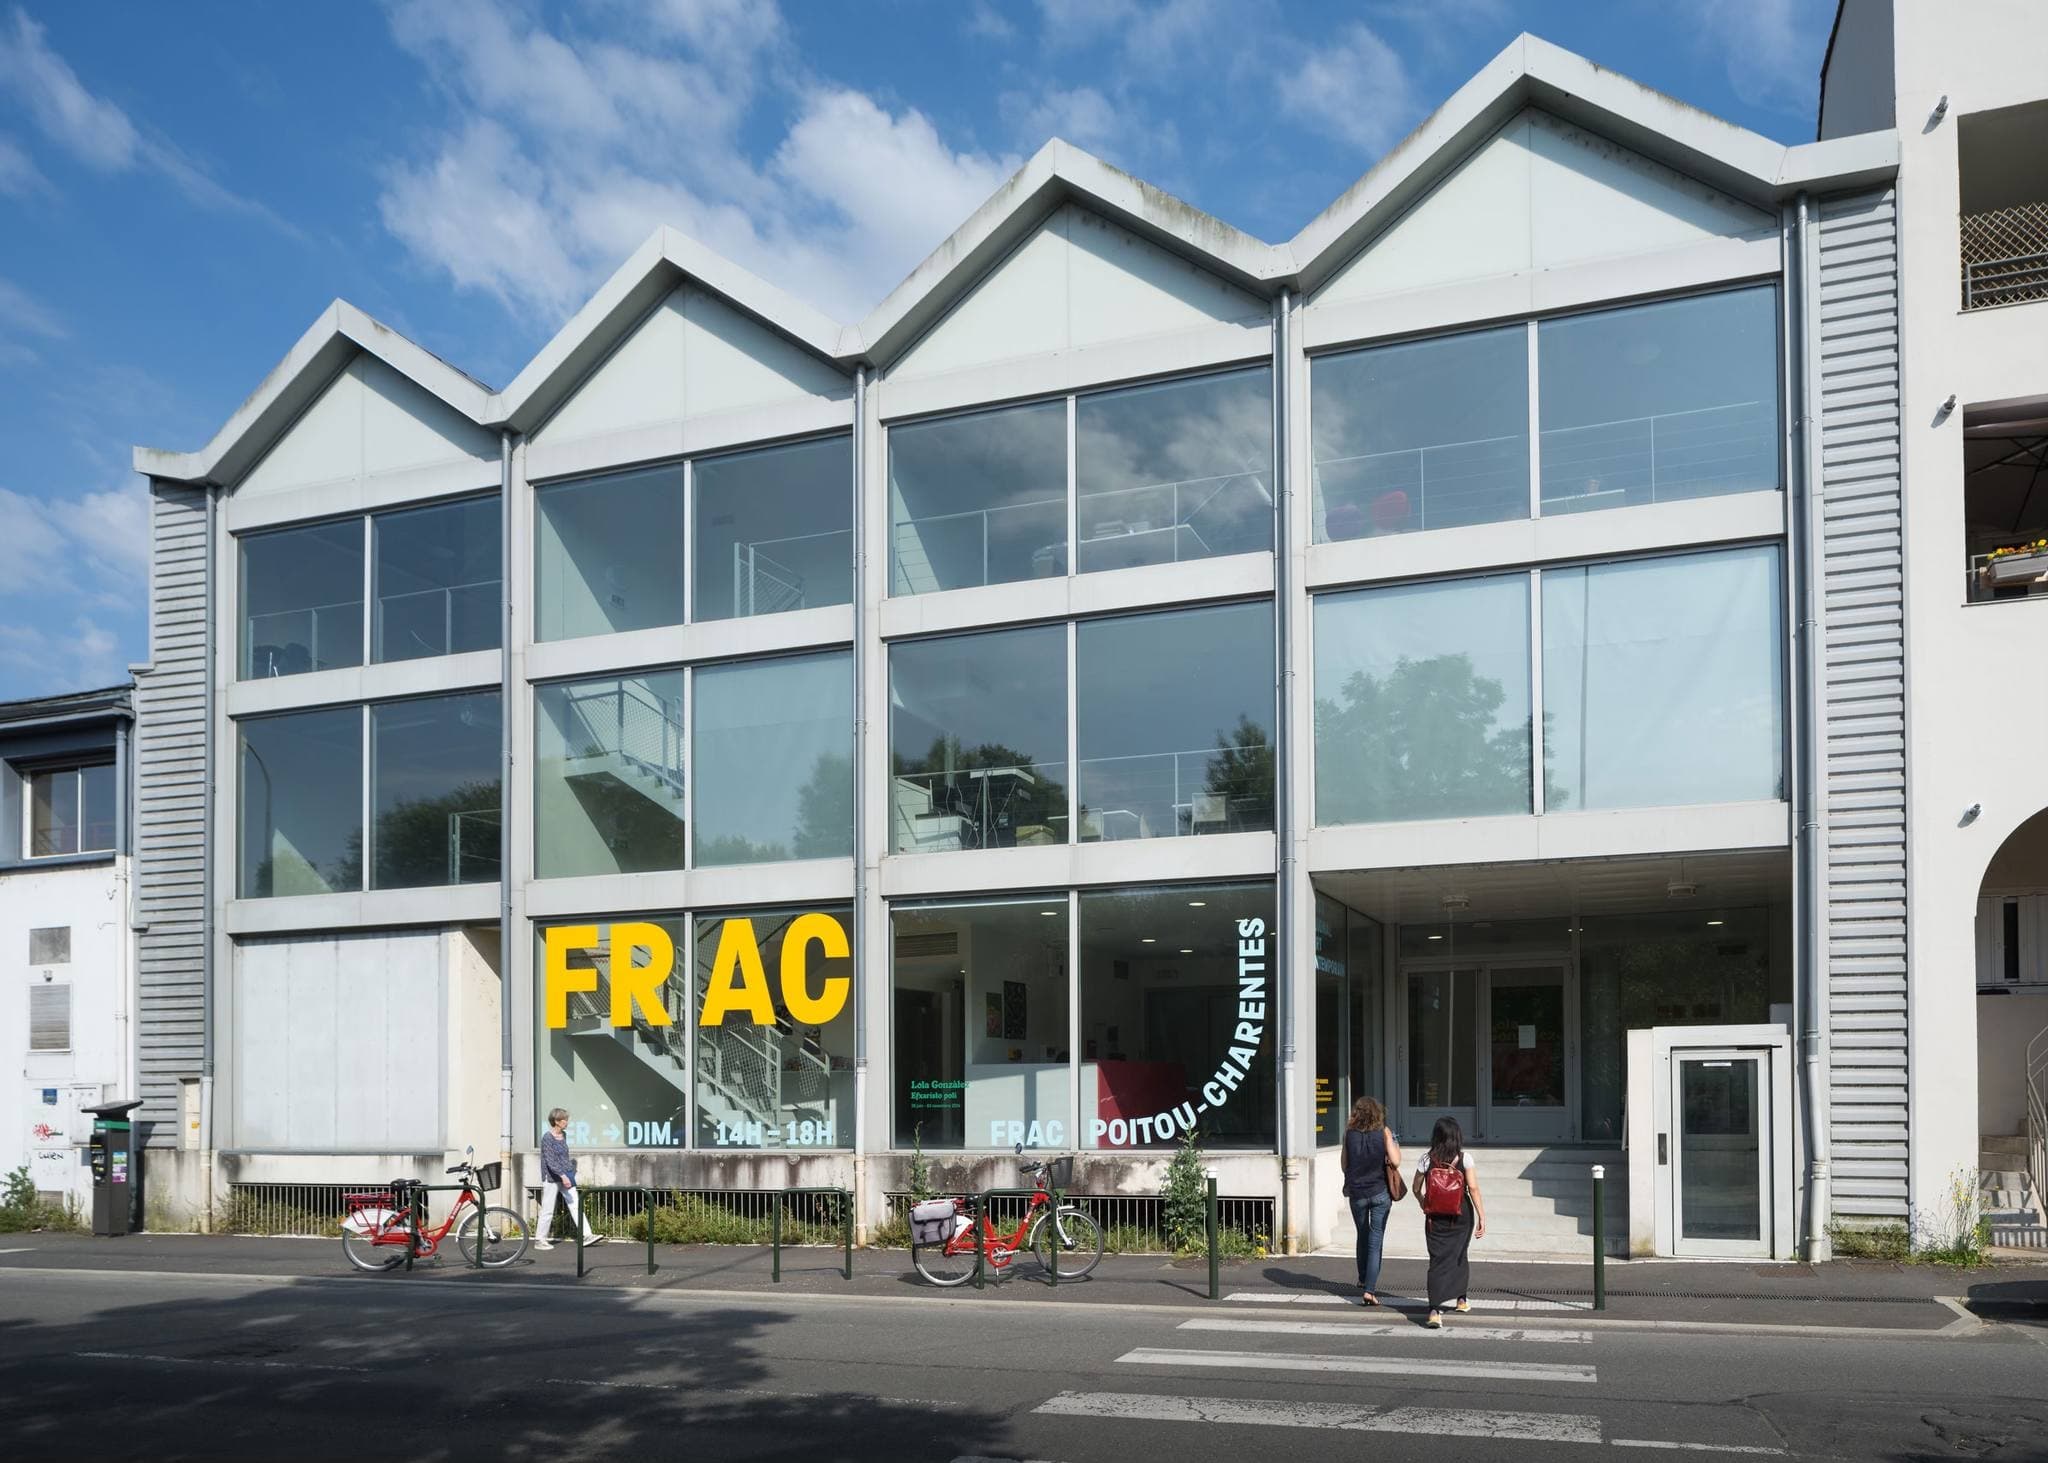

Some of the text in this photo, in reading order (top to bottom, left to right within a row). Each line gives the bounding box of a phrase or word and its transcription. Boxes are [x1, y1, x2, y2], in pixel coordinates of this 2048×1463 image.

[545, 912, 850, 1028] FRAC
[990, 917, 1265, 1147] FRAC POITOU-CHARENTES
[911, 1080, 930, 1089] Lola
[628, 1121, 679, 1146] DIM.
[716, 1120, 762, 1146] 14H
[786, 1120, 833, 1146] 18H
